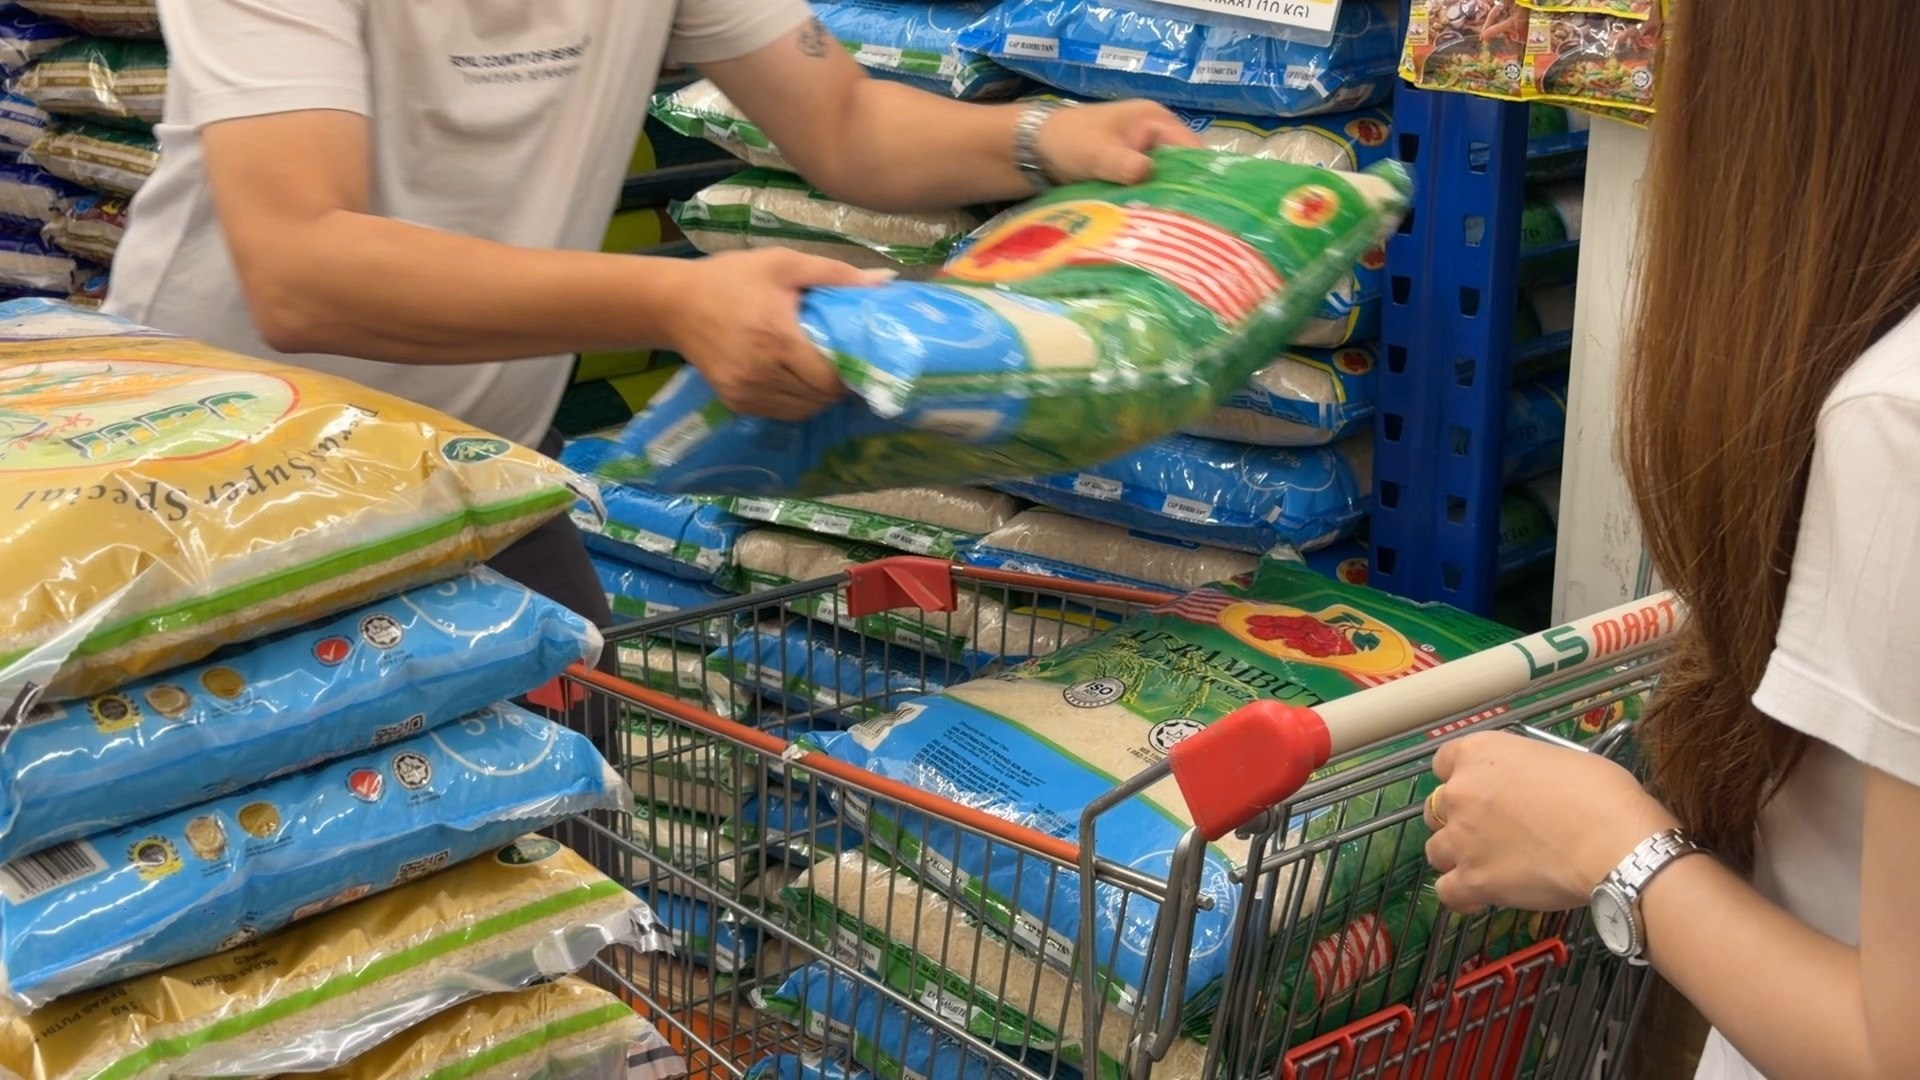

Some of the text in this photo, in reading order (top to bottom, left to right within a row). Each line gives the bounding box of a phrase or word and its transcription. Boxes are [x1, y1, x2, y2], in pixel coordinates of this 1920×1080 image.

[15, 480, 189, 522] Special
[203, 455, 318, 506] Super
[1512, 600, 1676, 680] LS MART
[1085, 682, 1113, 695] ISO
[1174, 642, 1328, 708] RAMBUT
